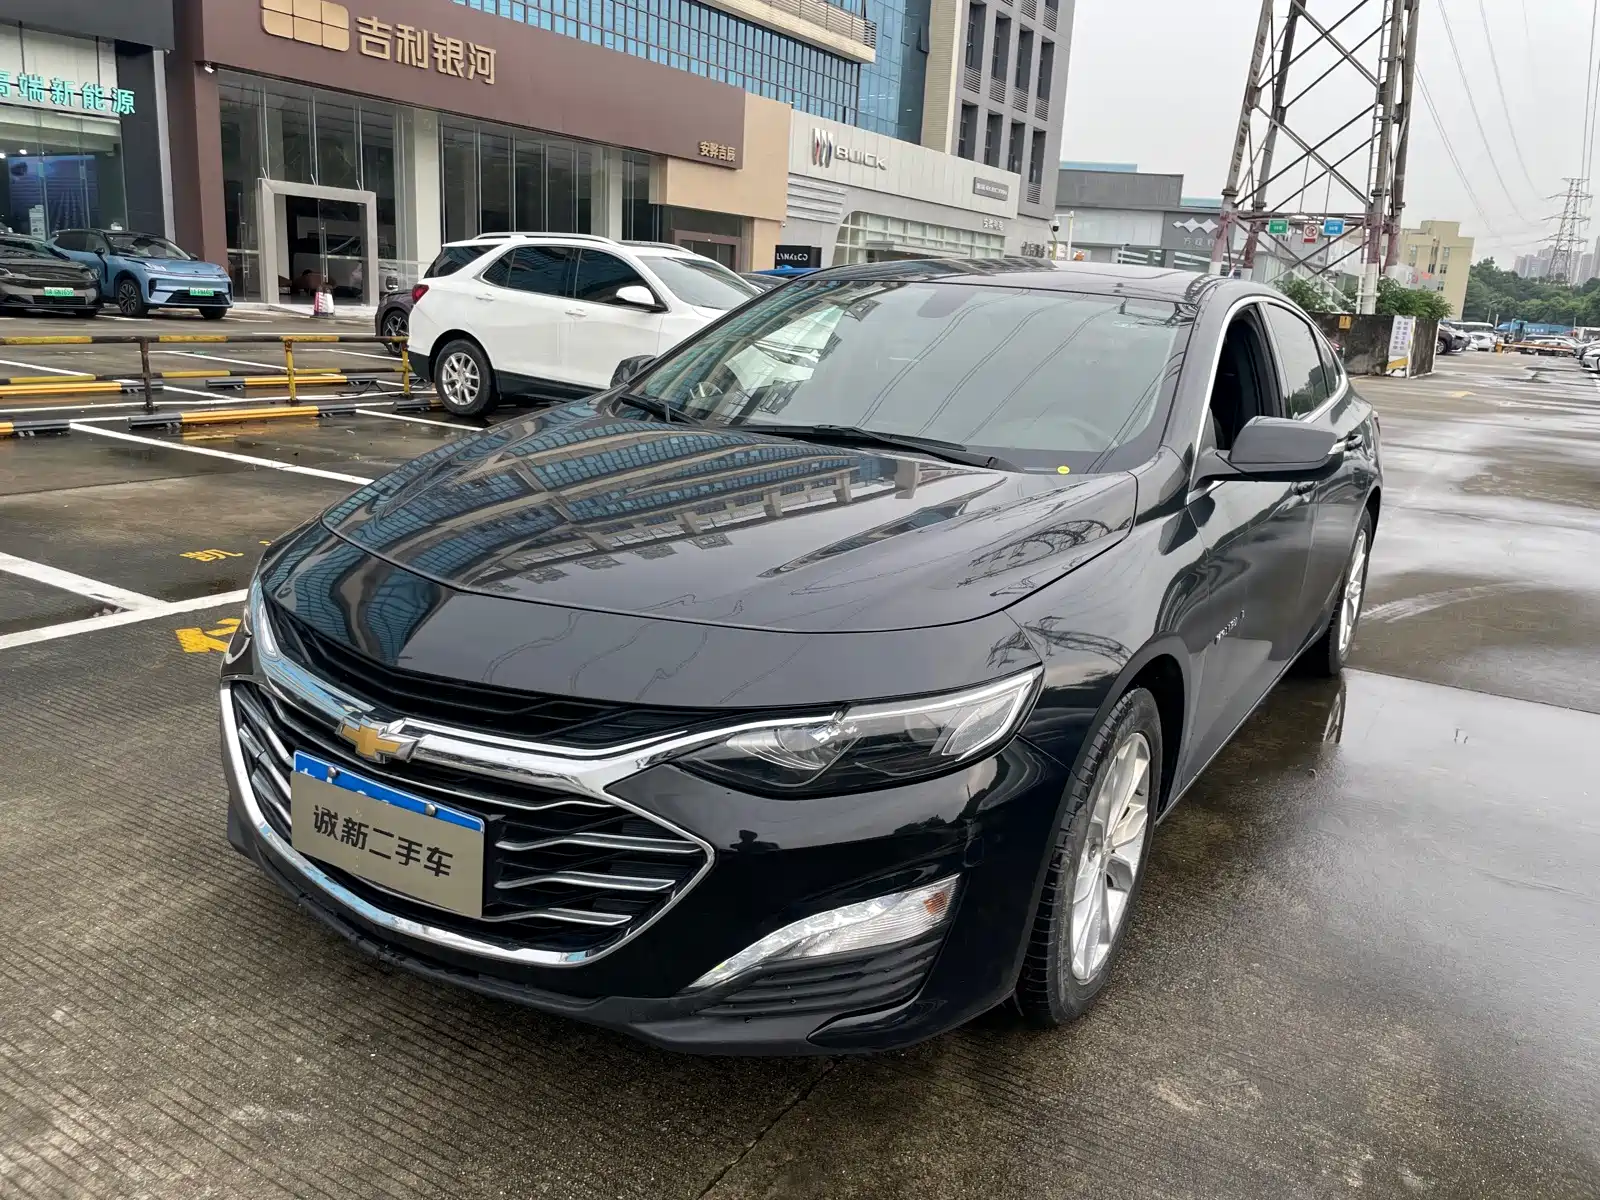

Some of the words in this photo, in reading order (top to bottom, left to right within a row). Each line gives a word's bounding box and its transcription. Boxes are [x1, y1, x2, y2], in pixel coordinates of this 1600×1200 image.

[356, 16, 497, 85] 吉利银河
[0, 70, 136, 115] 高端新能源
[834, 145, 888, 170] BUICK
[313, 805, 453, 877] 诚新二手车
